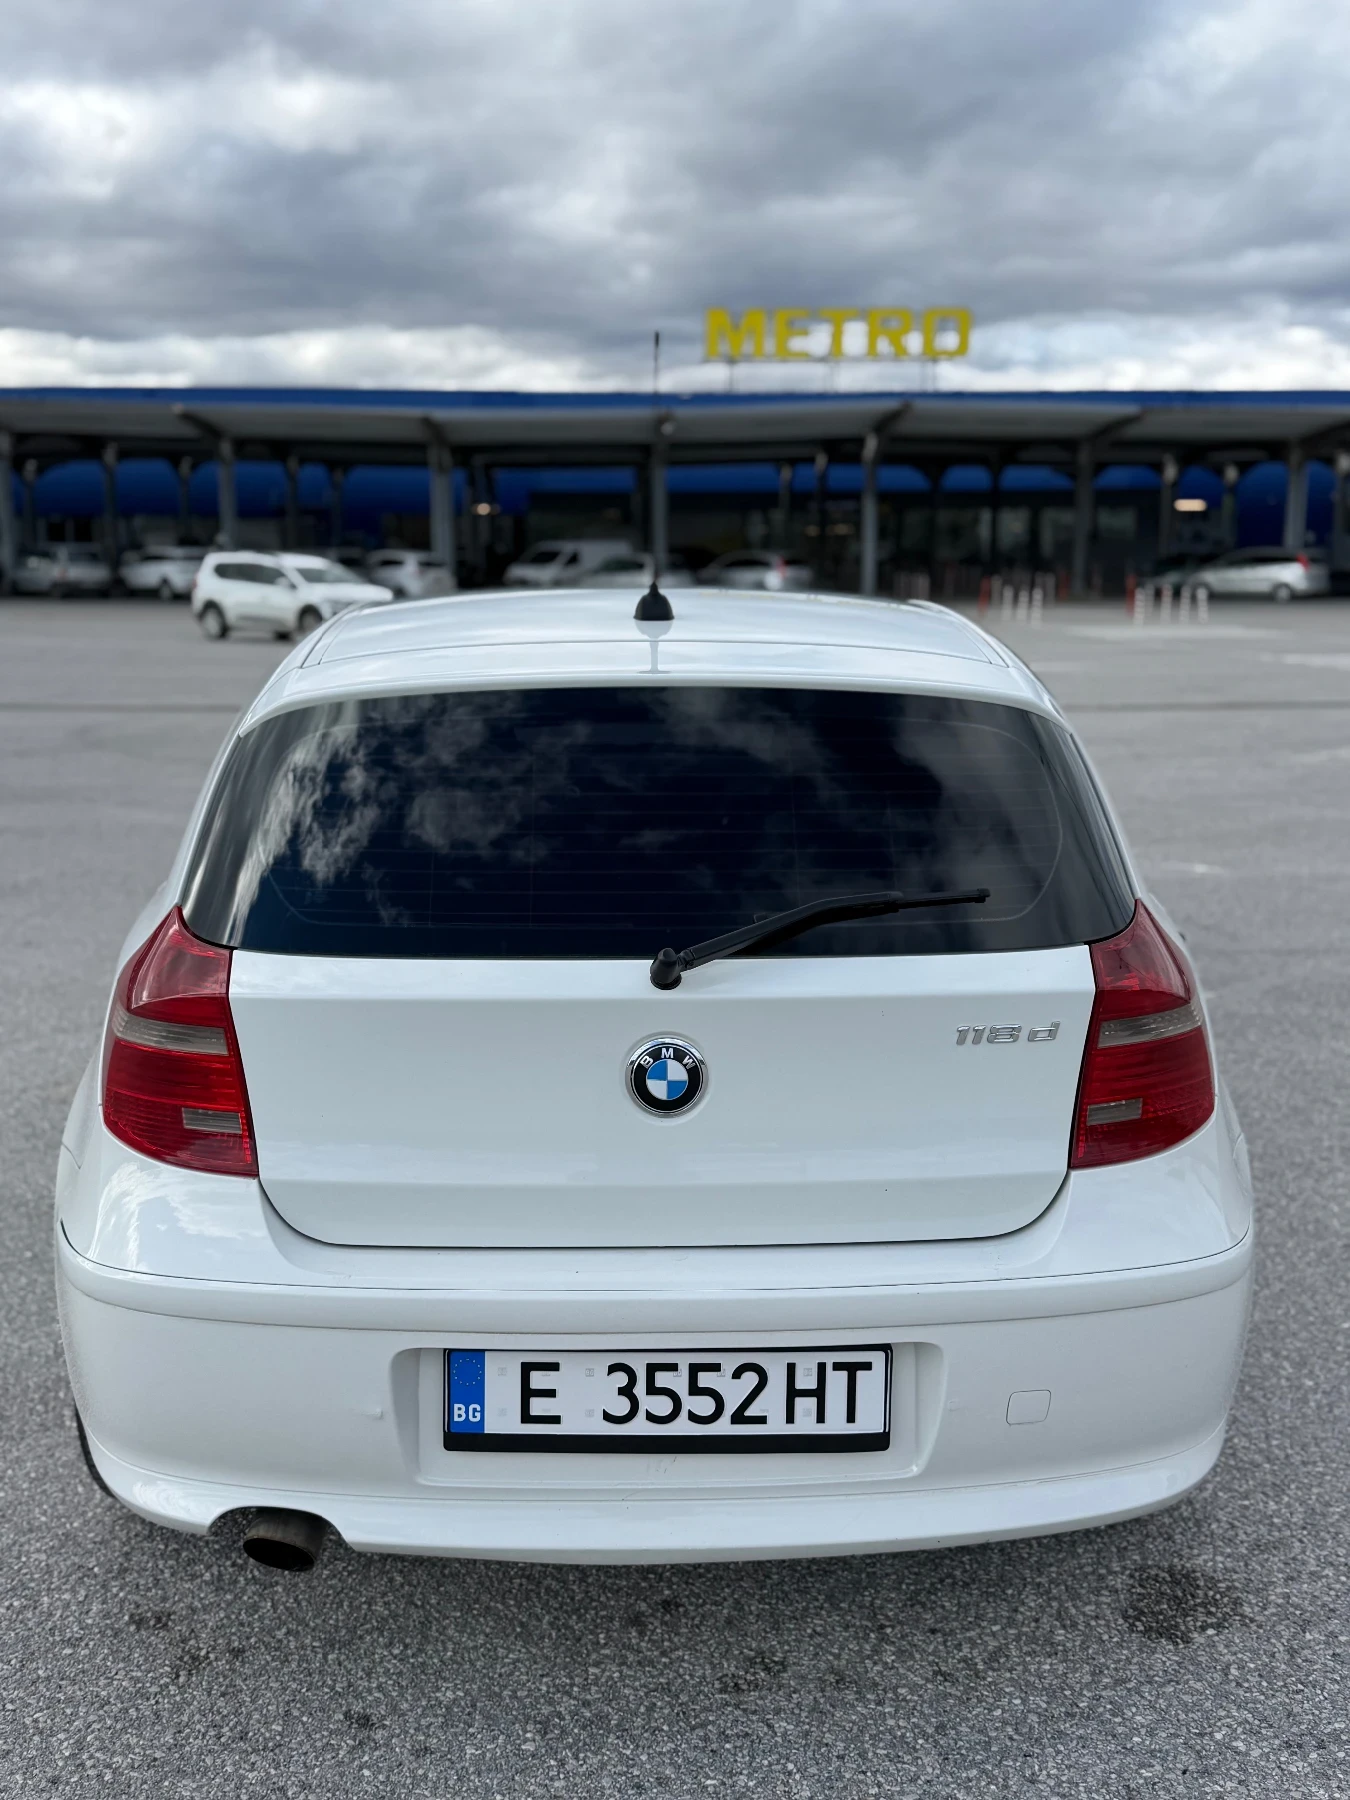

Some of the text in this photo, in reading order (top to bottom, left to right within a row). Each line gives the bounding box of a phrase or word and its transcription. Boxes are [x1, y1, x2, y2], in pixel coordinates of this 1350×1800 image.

[706, 306, 973, 359] METRO
[639, 1047, 697, 1070] BMW
[520, 1361, 562, 1425] E
[453, 1403, 481, 1422] BG
